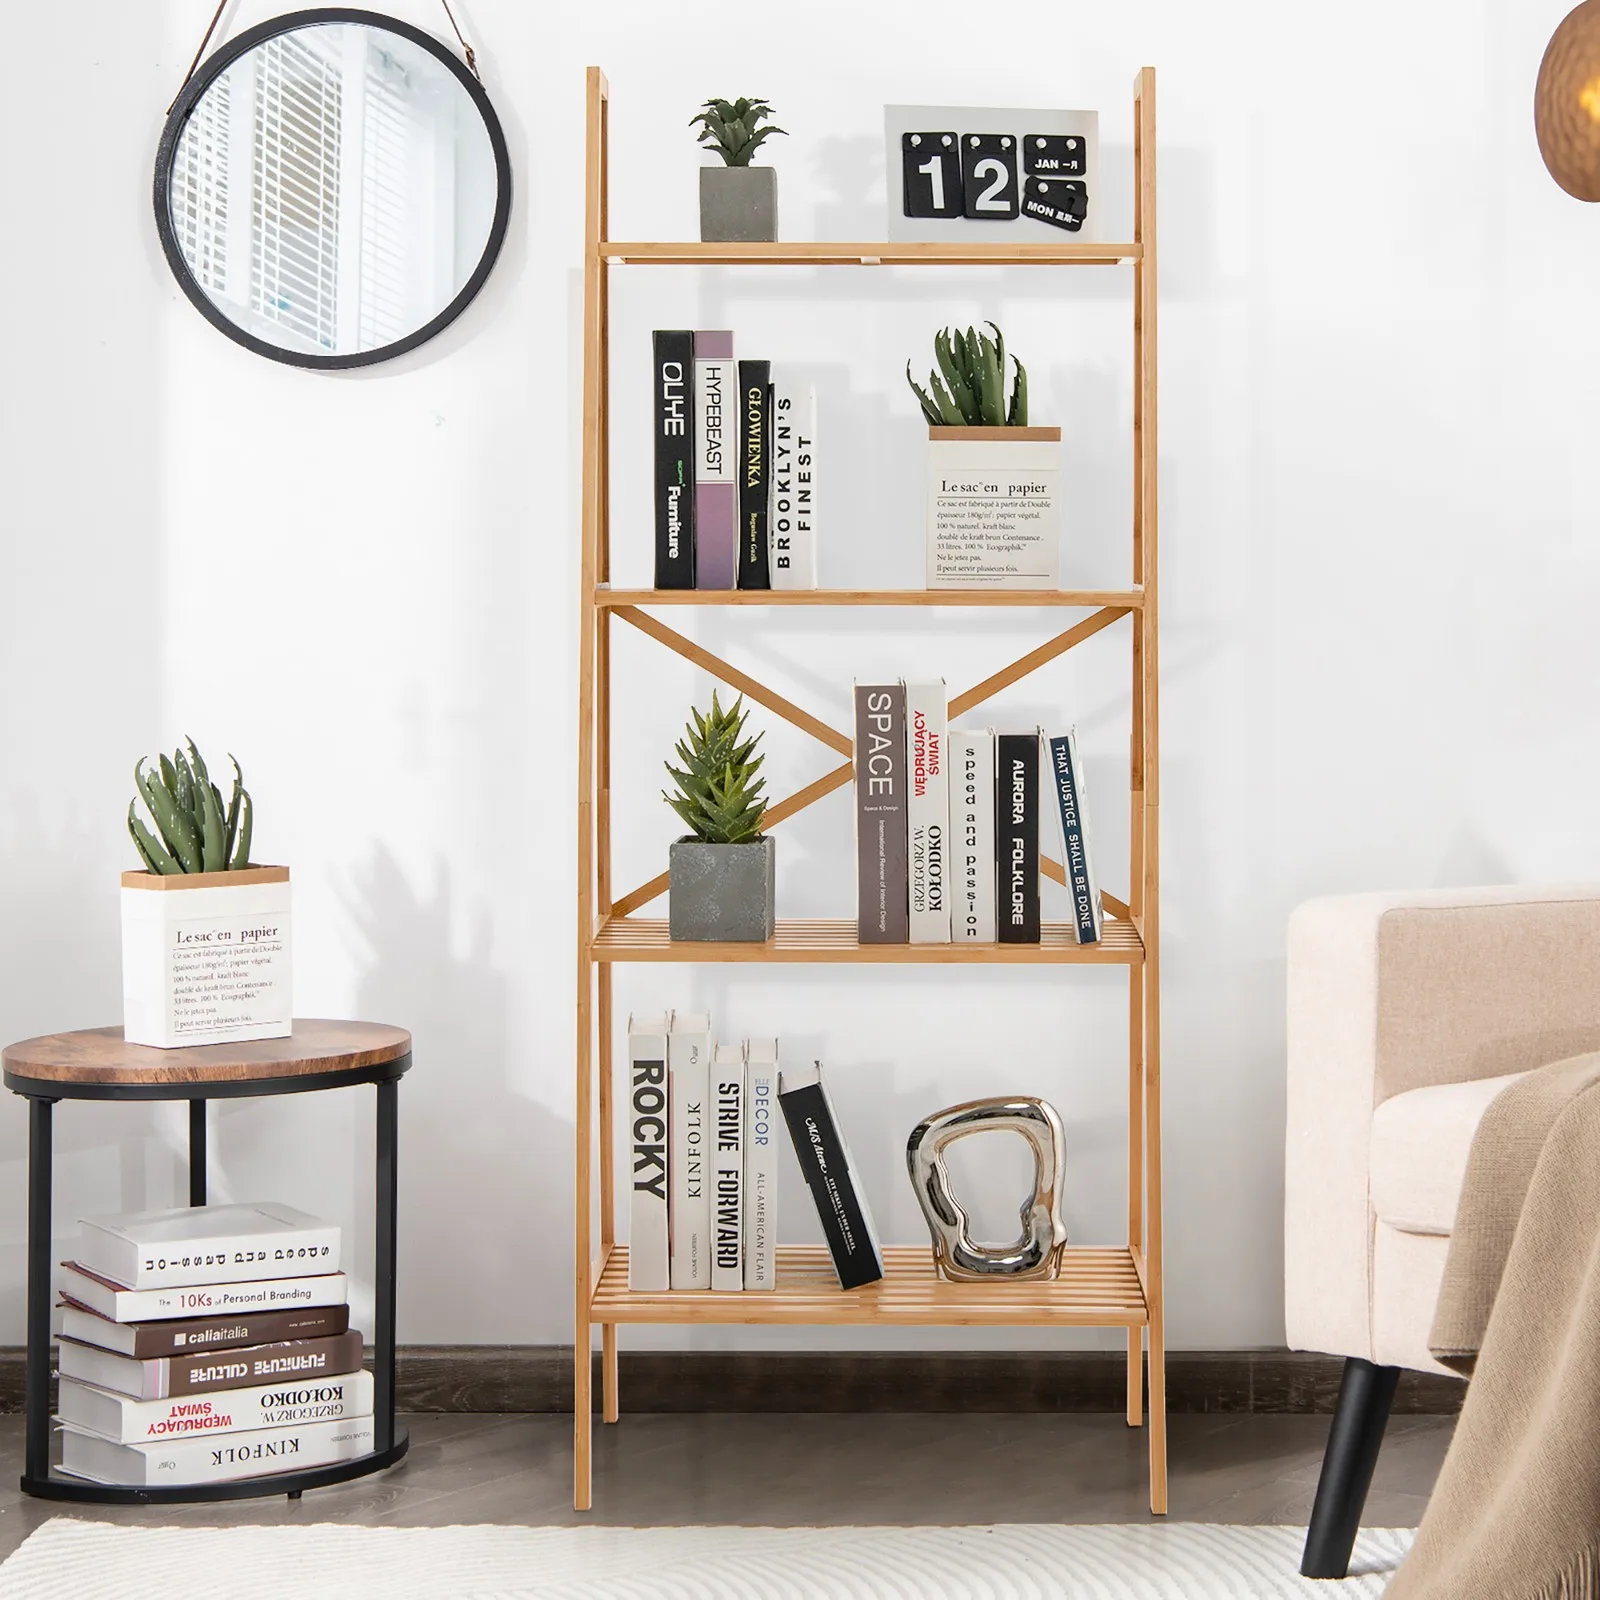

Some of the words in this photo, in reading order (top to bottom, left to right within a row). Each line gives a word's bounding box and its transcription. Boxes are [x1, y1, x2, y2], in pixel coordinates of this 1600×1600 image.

[1035, 159, 1059, 170] JAN
[1027, 200, 1054, 217] MON
[706, 367, 722, 474] HYPEBEAST
[748, 387, 762, 488] GŁOWIENKA
[777, 398, 791, 569] BROOKLYN'S
[798, 436, 811, 531] FINEST
[942, 480, 958, 492] Le
[984, 483, 998, 492] en
[1008, 482, 1047, 496] papier
[937, 500, 946, 508] Ce
[968, 500, 994, 509] fabriqué
[1000, 500, 1018, 509] partir
[1019, 500, 1027, 508] de
[996, 512, 1016, 520] papier
[667, 485, 681, 559] Furniture
[943, 565, 957, 573] peut
[976, 565, 1005, 573] plusieurs
[867, 692, 893, 796] SPACE
[915, 710, 927, 797] WĘDRUJĄCY
[926, 732, 939, 775] ŚWIAT
[1055, 744, 1069, 775] THAT
[965, 748, 975, 805] speed
[1012, 759, 1025, 825] AURORA
[1061, 778, 1076, 827] JUSTICE
[966, 813, 976, 847] and
[928, 825, 942, 912] KOŁODKO
[1069, 834, 1081, 873] SHALL
[914, 843, 924, 912] GRZEGORZ
[1011, 837, 1024, 926] FOLKLORE
[1075, 876, 1085, 892] BE
[965, 856, 977, 937] passion
[1077, 895, 1092, 929] DONE
[176, 930, 192, 944] Le
[217, 932, 231, 941] en
[241, 926, 278, 942] papier
[633, 1060, 666, 1200] ROCKY
[718, 1083, 740, 1152] STRIVE
[754, 1086, 769, 1146] DECOR
[687, 1102, 701, 1198] KINFOLK
[717, 1170, 739, 1269] FORWARD
[146, 1254, 226, 1271] passion
[235, 1251, 266, 1263] and
[275, 1246, 329, 1259] speed
[756, 1253, 764, 1281] FLAIR
[159, 1298, 170, 1306] The
[179, 1292, 212, 1308] 10Ks
[223, 1291, 266, 1304] Personal
[270, 1289, 312, 1301] Branding
[189, 1326, 249, 1344] caliaitalia
[189, 1361, 248, 1383] CULTURE
[254, 1353, 326, 1374] FURNITURE
[169, 1402, 212, 1417] ŚWIAT
[261, 1386, 344, 1408] KOŁODKO
[277, 1404, 344, 1421] GRZEGORZ
[147, 1415, 233, 1435] WĘDRUJĄCY
[211, 1438, 300, 1466] KINFOLK
